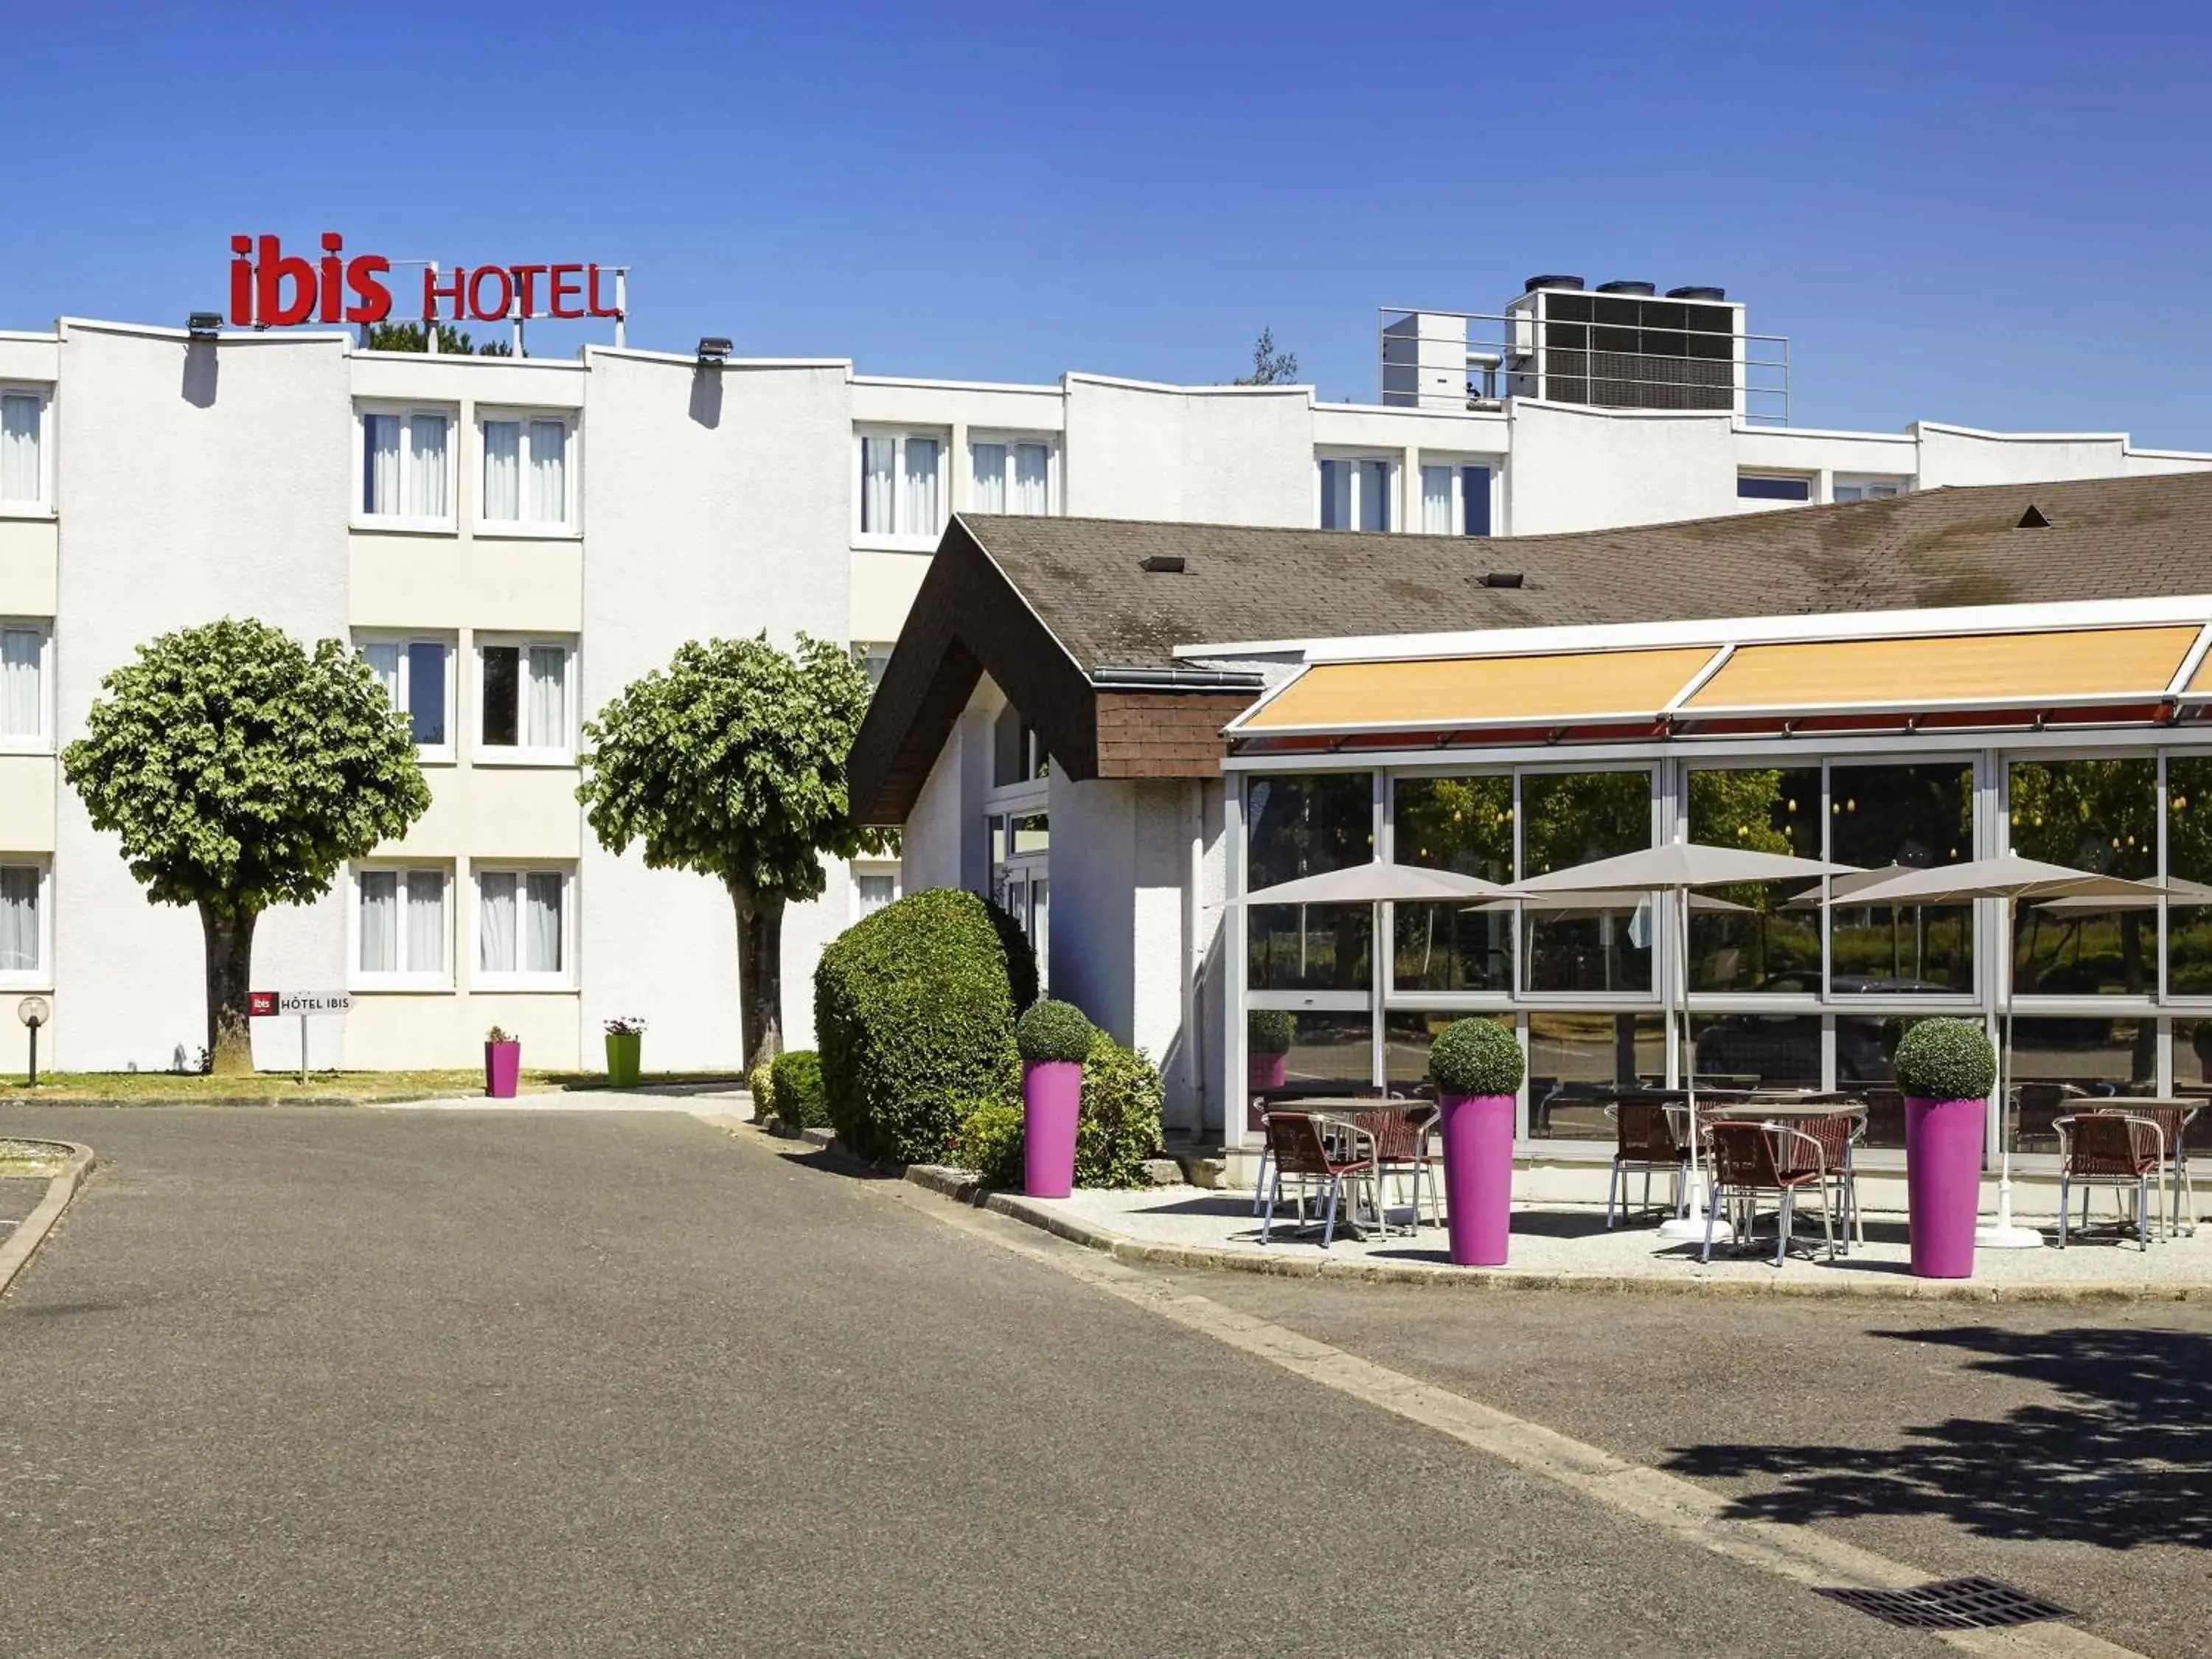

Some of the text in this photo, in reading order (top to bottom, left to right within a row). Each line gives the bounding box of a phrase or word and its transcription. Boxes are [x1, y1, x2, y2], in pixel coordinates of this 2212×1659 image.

[231, 232, 621, 326] ibis HOTEL
[254, 998, 270, 1008] ibis
[327, 998, 349, 1008] IBIS
